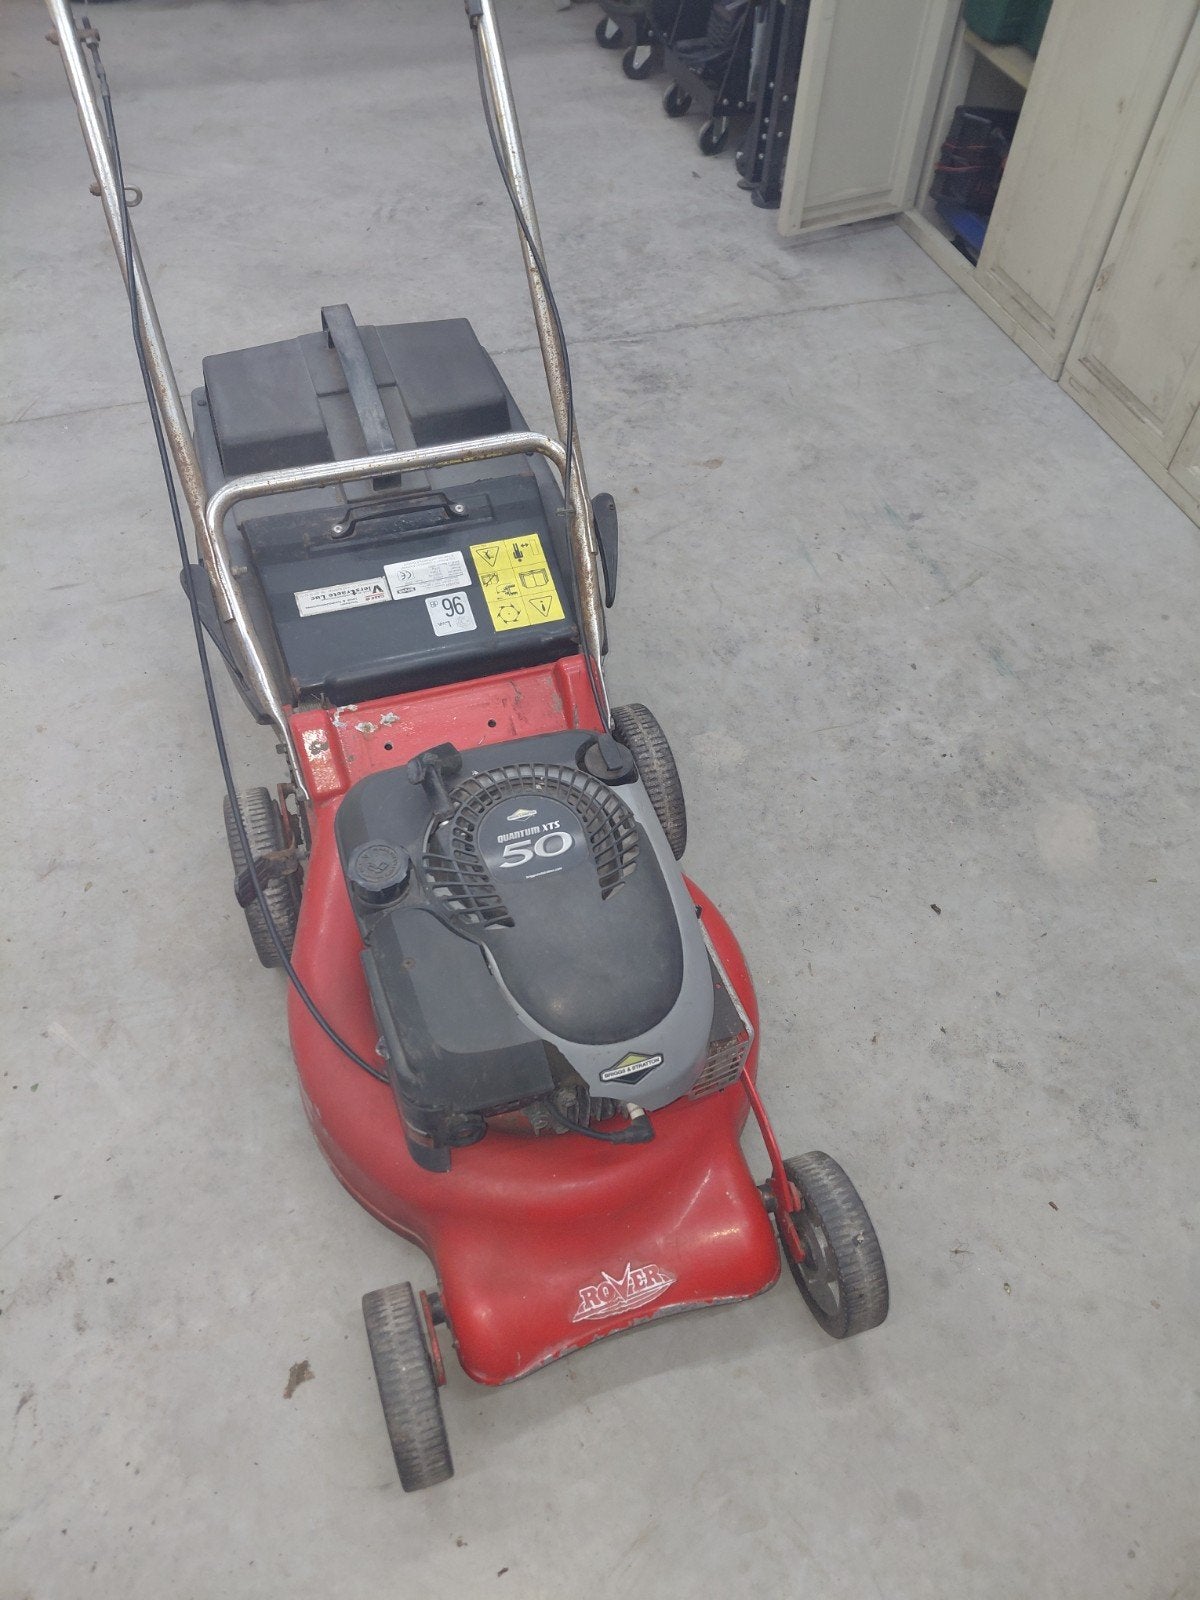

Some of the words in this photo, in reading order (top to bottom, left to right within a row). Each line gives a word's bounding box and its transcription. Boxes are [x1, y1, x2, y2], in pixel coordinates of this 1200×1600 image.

[442, 597, 465, 617] 96
[497, 827, 541, 843] QUANTUM
[542, 820, 561, 832] XTS
[499, 831, 573, 868] 50
[604, 1069, 626, 1079] BRIGGS
[632, 1057, 660, 1070] STRATTON
[577, 1262, 667, 1311] ROVER
